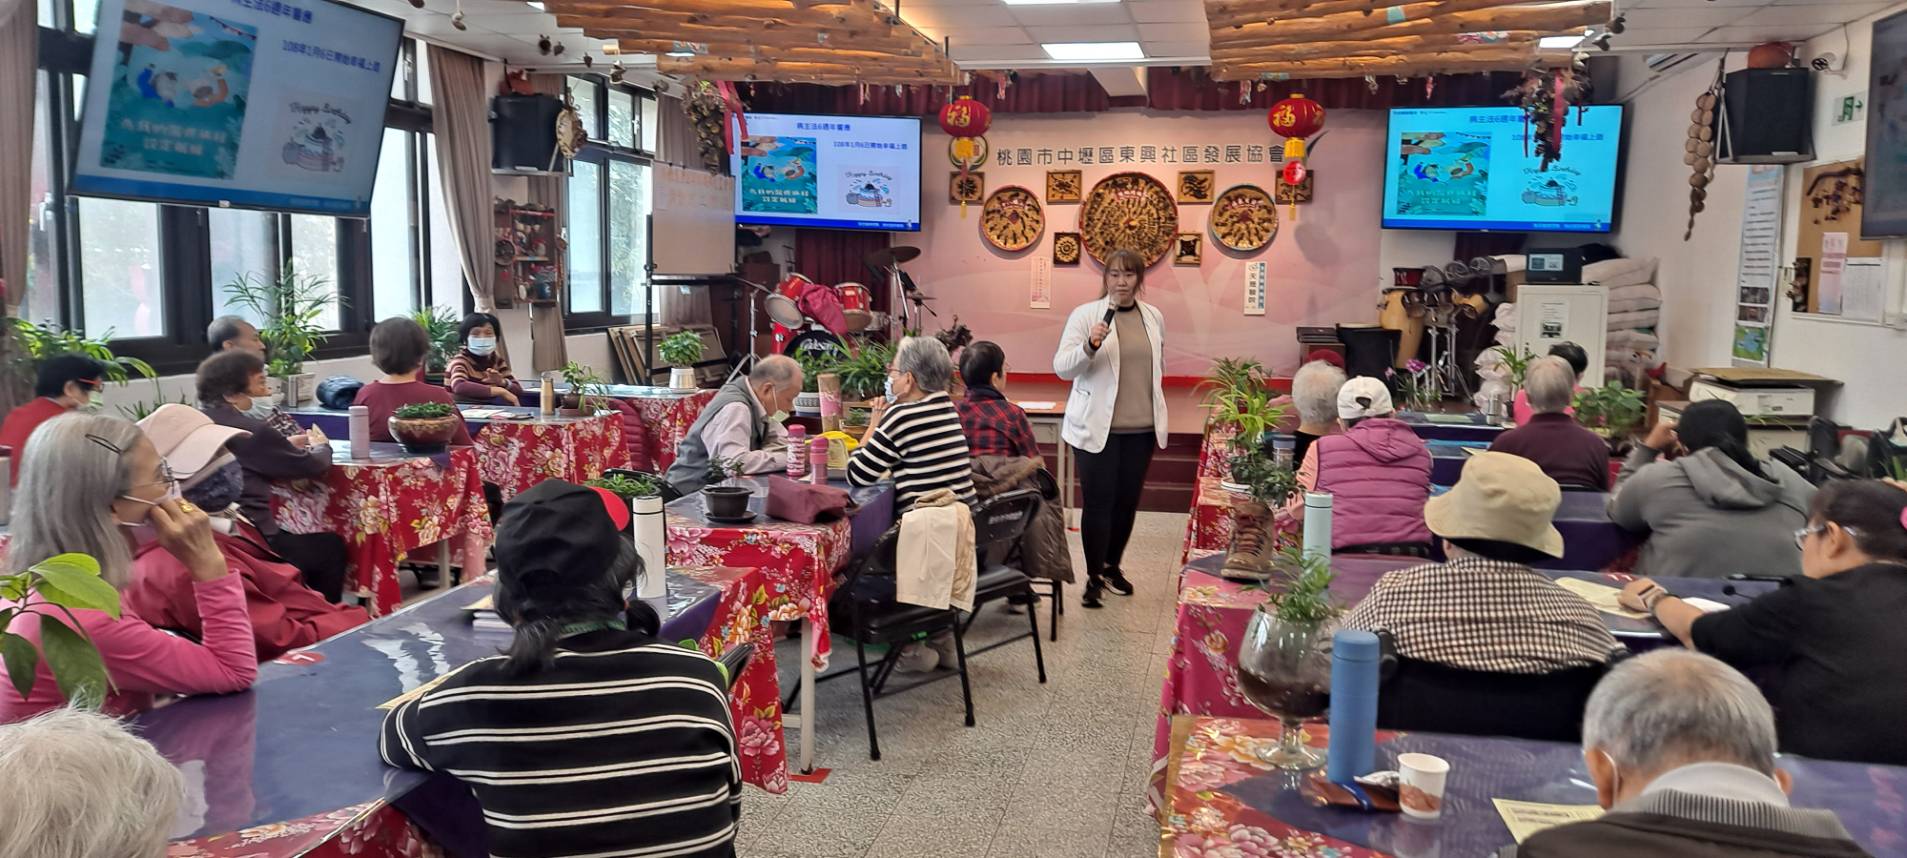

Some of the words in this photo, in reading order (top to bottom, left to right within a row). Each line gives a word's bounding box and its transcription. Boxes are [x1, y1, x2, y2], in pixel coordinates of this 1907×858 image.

[947, 104, 971, 127] 福
[1272, 104, 1297, 127] 福
[996, 145, 1284, 166] 桃園市中壢區東興社區發展協會
